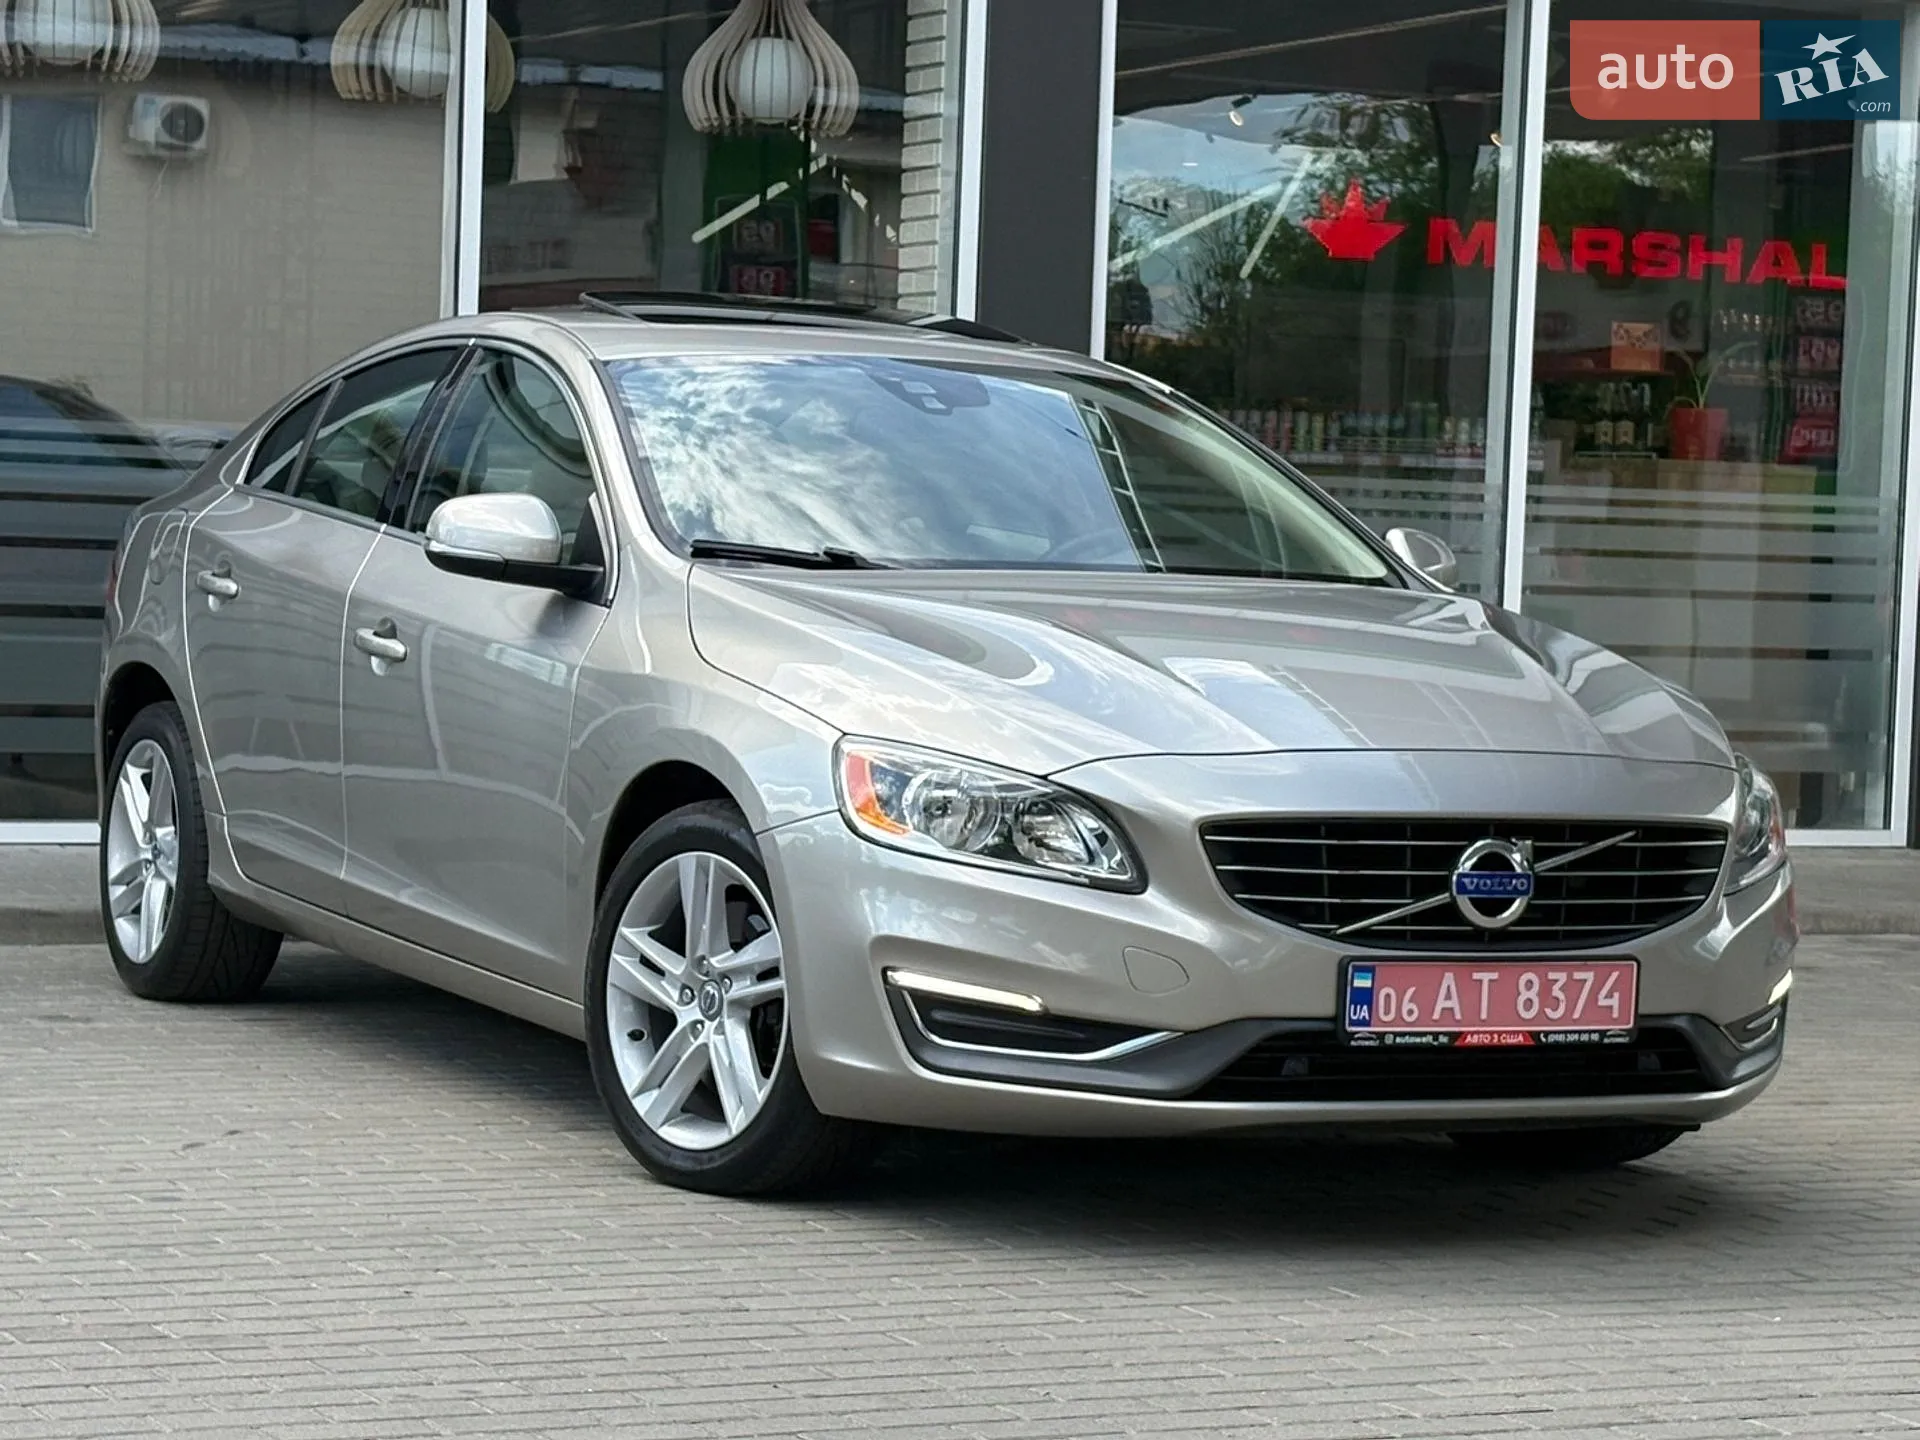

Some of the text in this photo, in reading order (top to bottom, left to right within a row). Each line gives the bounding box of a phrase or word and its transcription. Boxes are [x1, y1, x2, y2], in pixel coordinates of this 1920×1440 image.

[1461, 878, 1528, 891] VOLVO
[1377, 970, 1621, 1023] 06 AT 8374
[1350, 1004, 1370, 1020] UA
[1465, 1033, 1493, 1043] АВТО
[1501, 1033, 1524, 1043] США
